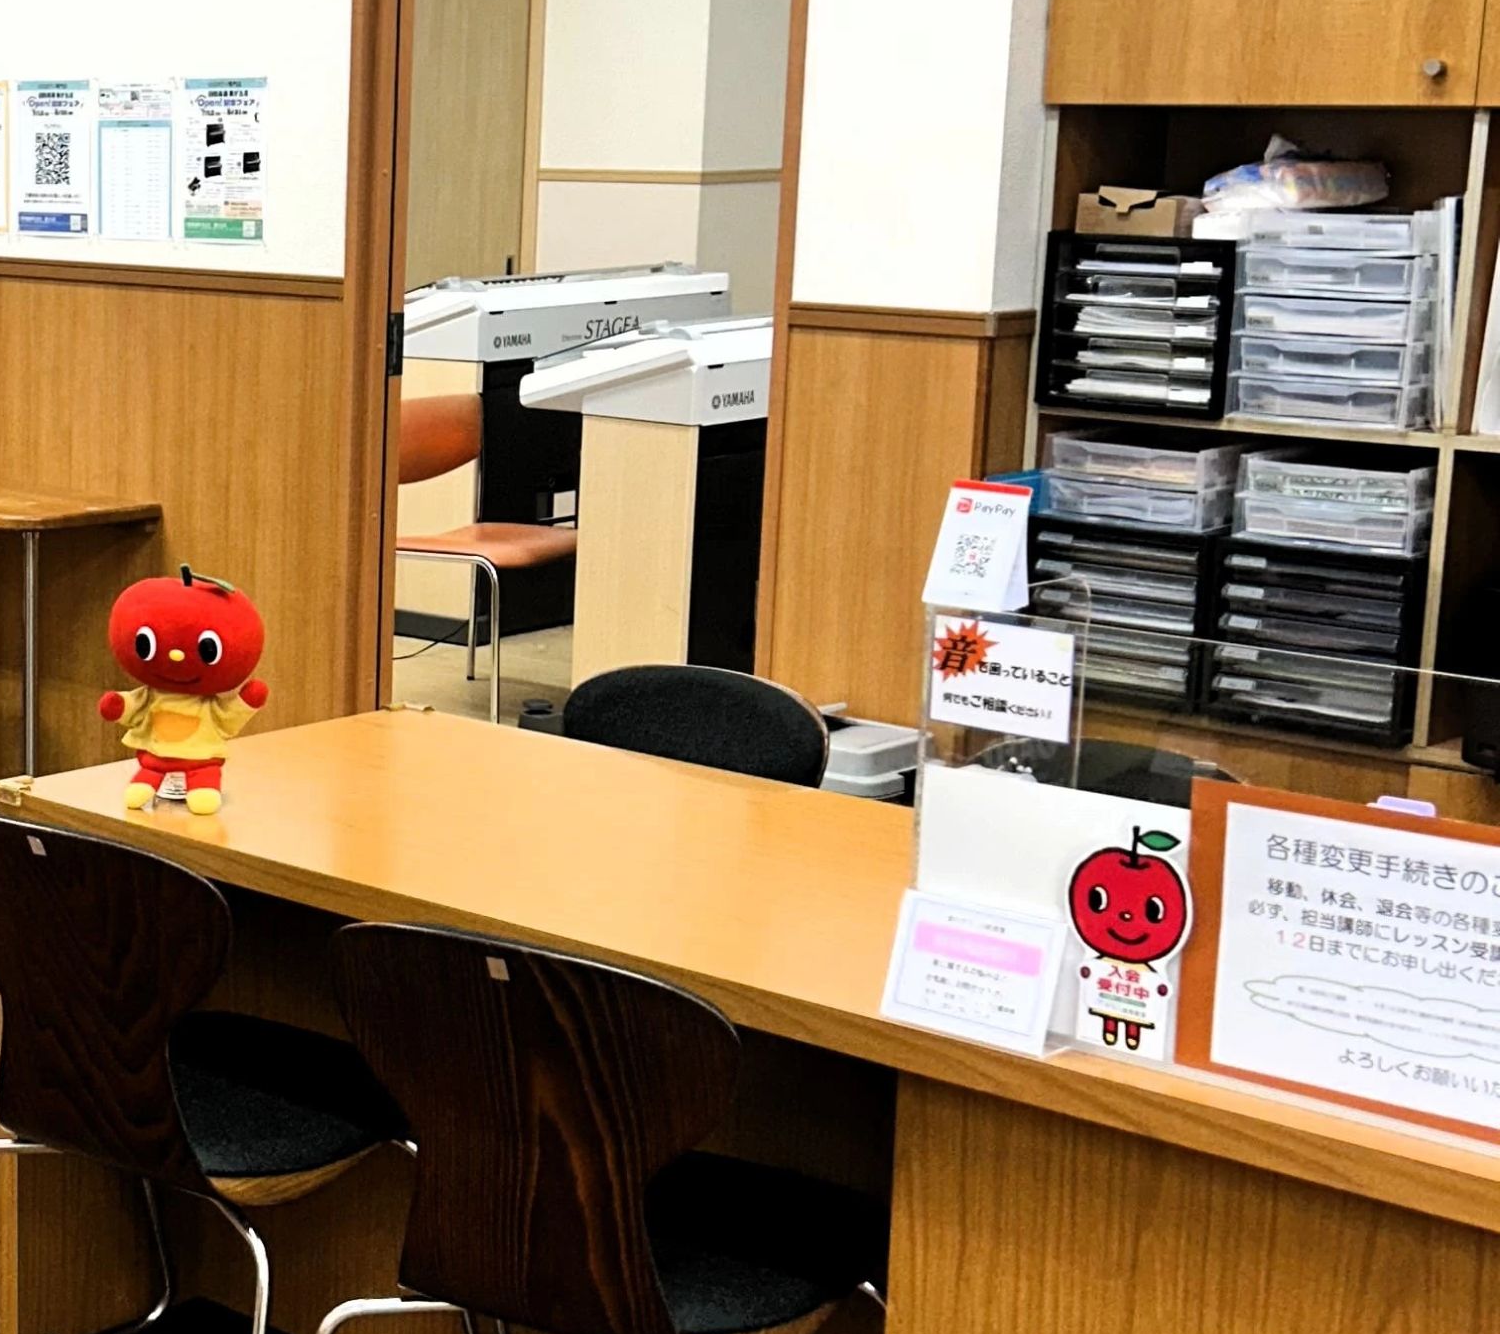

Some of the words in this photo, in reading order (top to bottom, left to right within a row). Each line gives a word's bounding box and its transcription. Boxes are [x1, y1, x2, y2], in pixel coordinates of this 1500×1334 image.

[584, 315, 641, 340] STAGEA
[503, 333, 531, 348] YAMAHA
[722, 389, 755, 408] YAMAHA
[974, 501, 1016, 517] PayPay
[1276, 928, 1500, 989] 12日までにお申し出くだ
[1108, 964, 1141, 984] 入会
[1097, 977, 1151, 1001] 受付中
